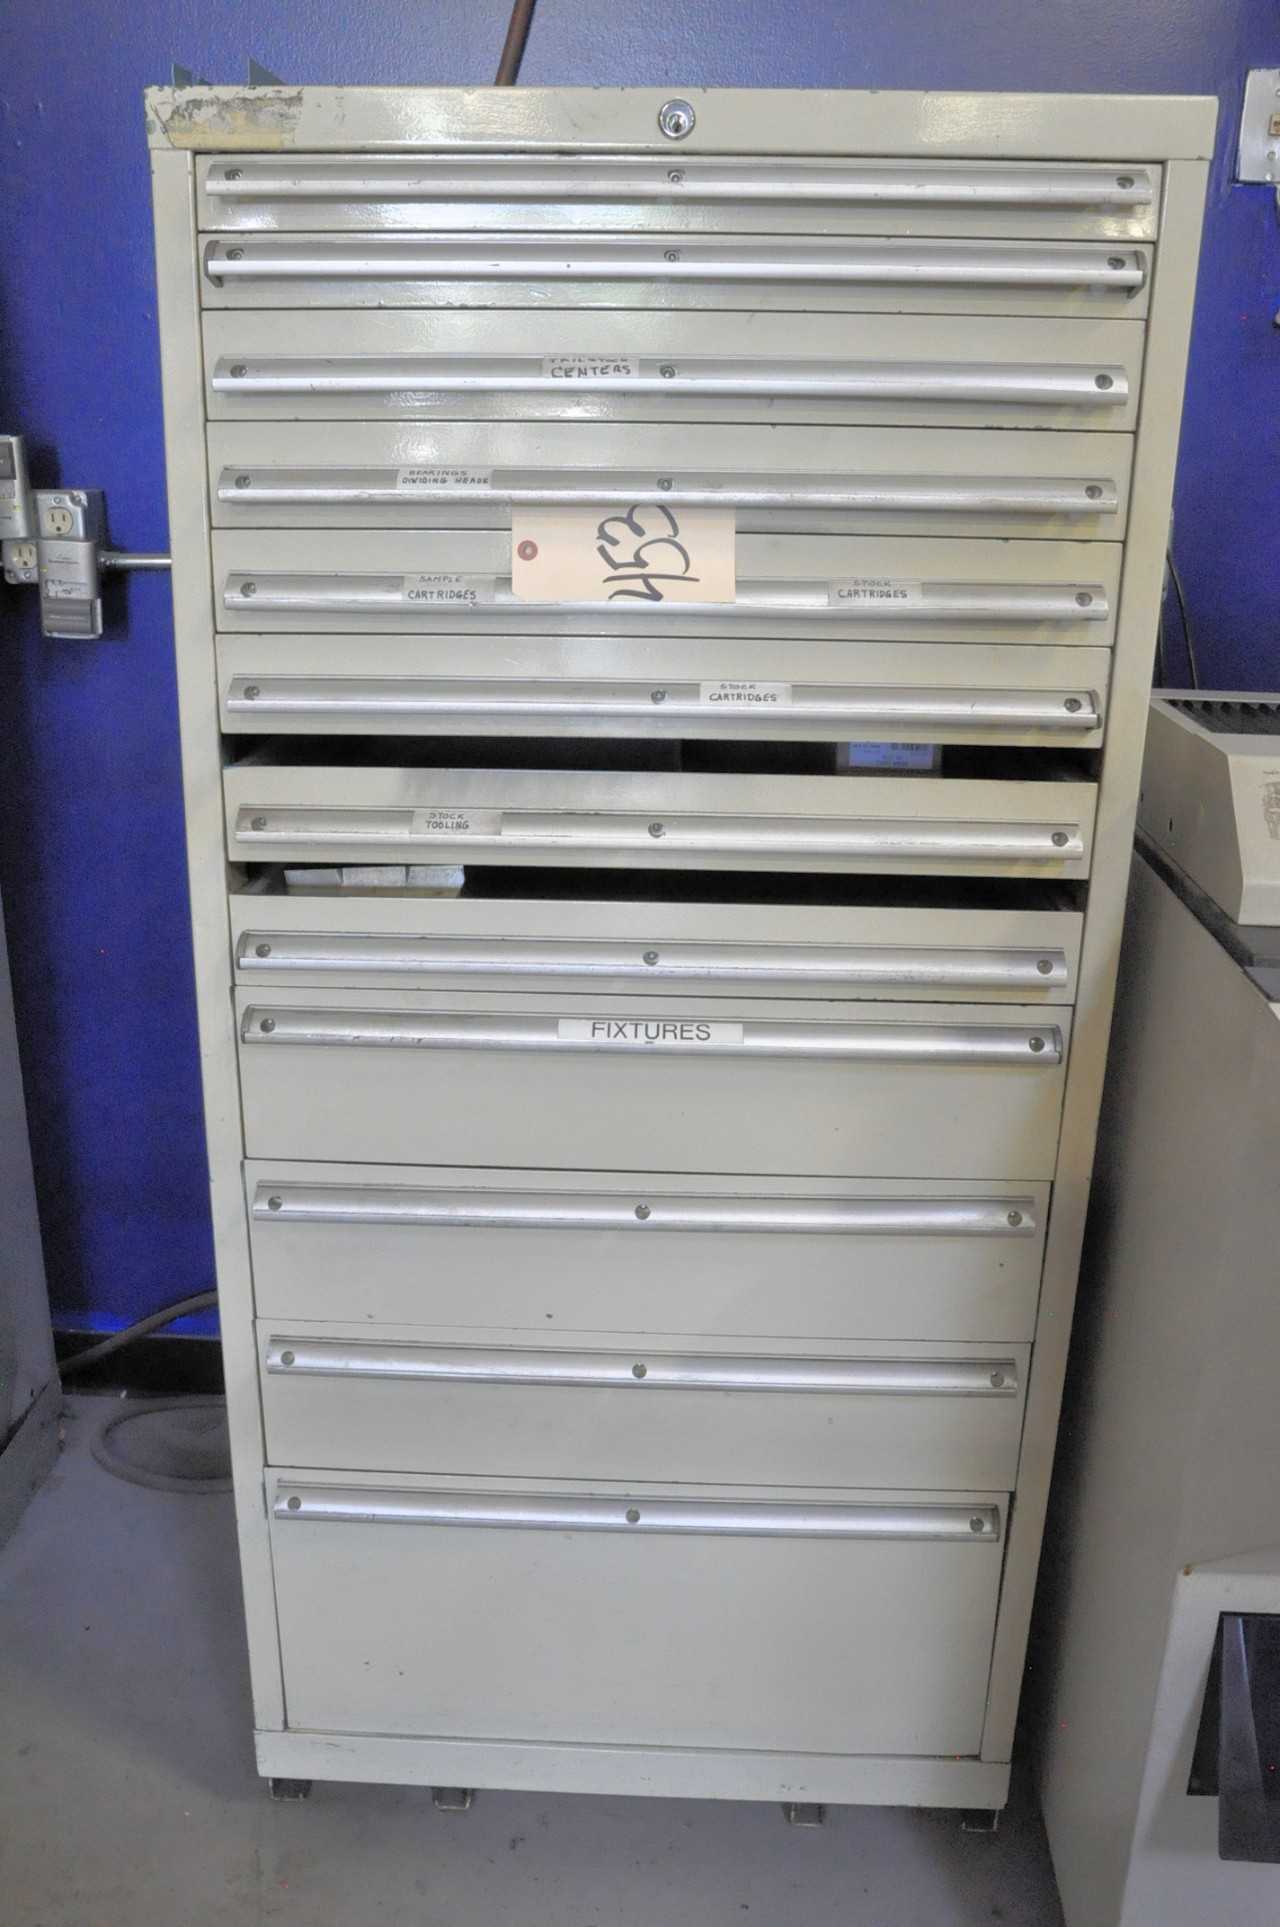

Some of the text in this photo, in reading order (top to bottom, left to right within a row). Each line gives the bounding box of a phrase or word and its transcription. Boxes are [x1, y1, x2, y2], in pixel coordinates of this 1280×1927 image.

[550, 365, 631, 378] CENTERS
[401, 476, 448, 484] DIVIDING
[596, 504, 701, 602] 453
[407, 589, 477, 600] CARTRIDGES
[838, 588, 908, 599] CARTRIDGES
[720, 682, 756, 690] STOCK
[708, 692, 777, 702] CARTRIDGES
[428, 812, 465, 820] STOCK
[425, 820, 470, 830] TOOLING
[591, 1021, 711, 1041] FIXTURES
